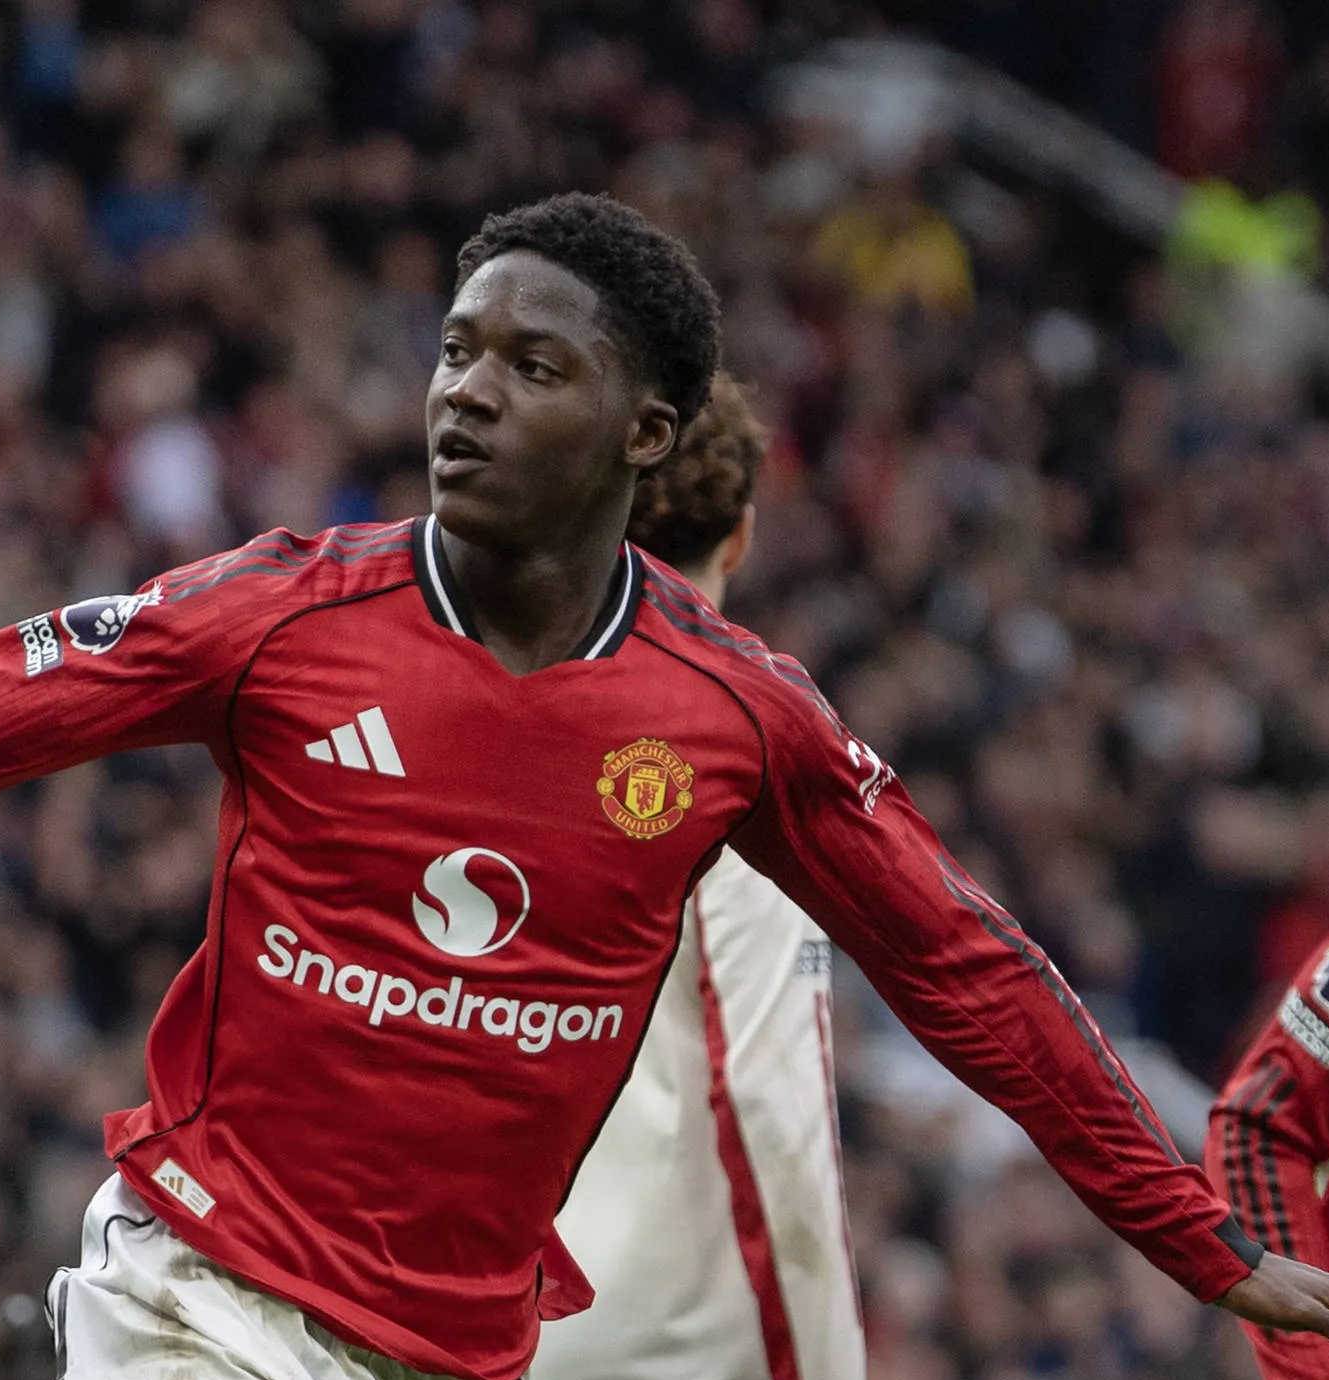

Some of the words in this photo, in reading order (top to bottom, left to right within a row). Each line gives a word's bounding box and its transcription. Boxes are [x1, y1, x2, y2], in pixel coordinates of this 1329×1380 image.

[610, 744, 687, 784] MANCHESTER
[615, 810, 669, 832] UNITED
[257, 923, 623, 1053] Snapdragon
